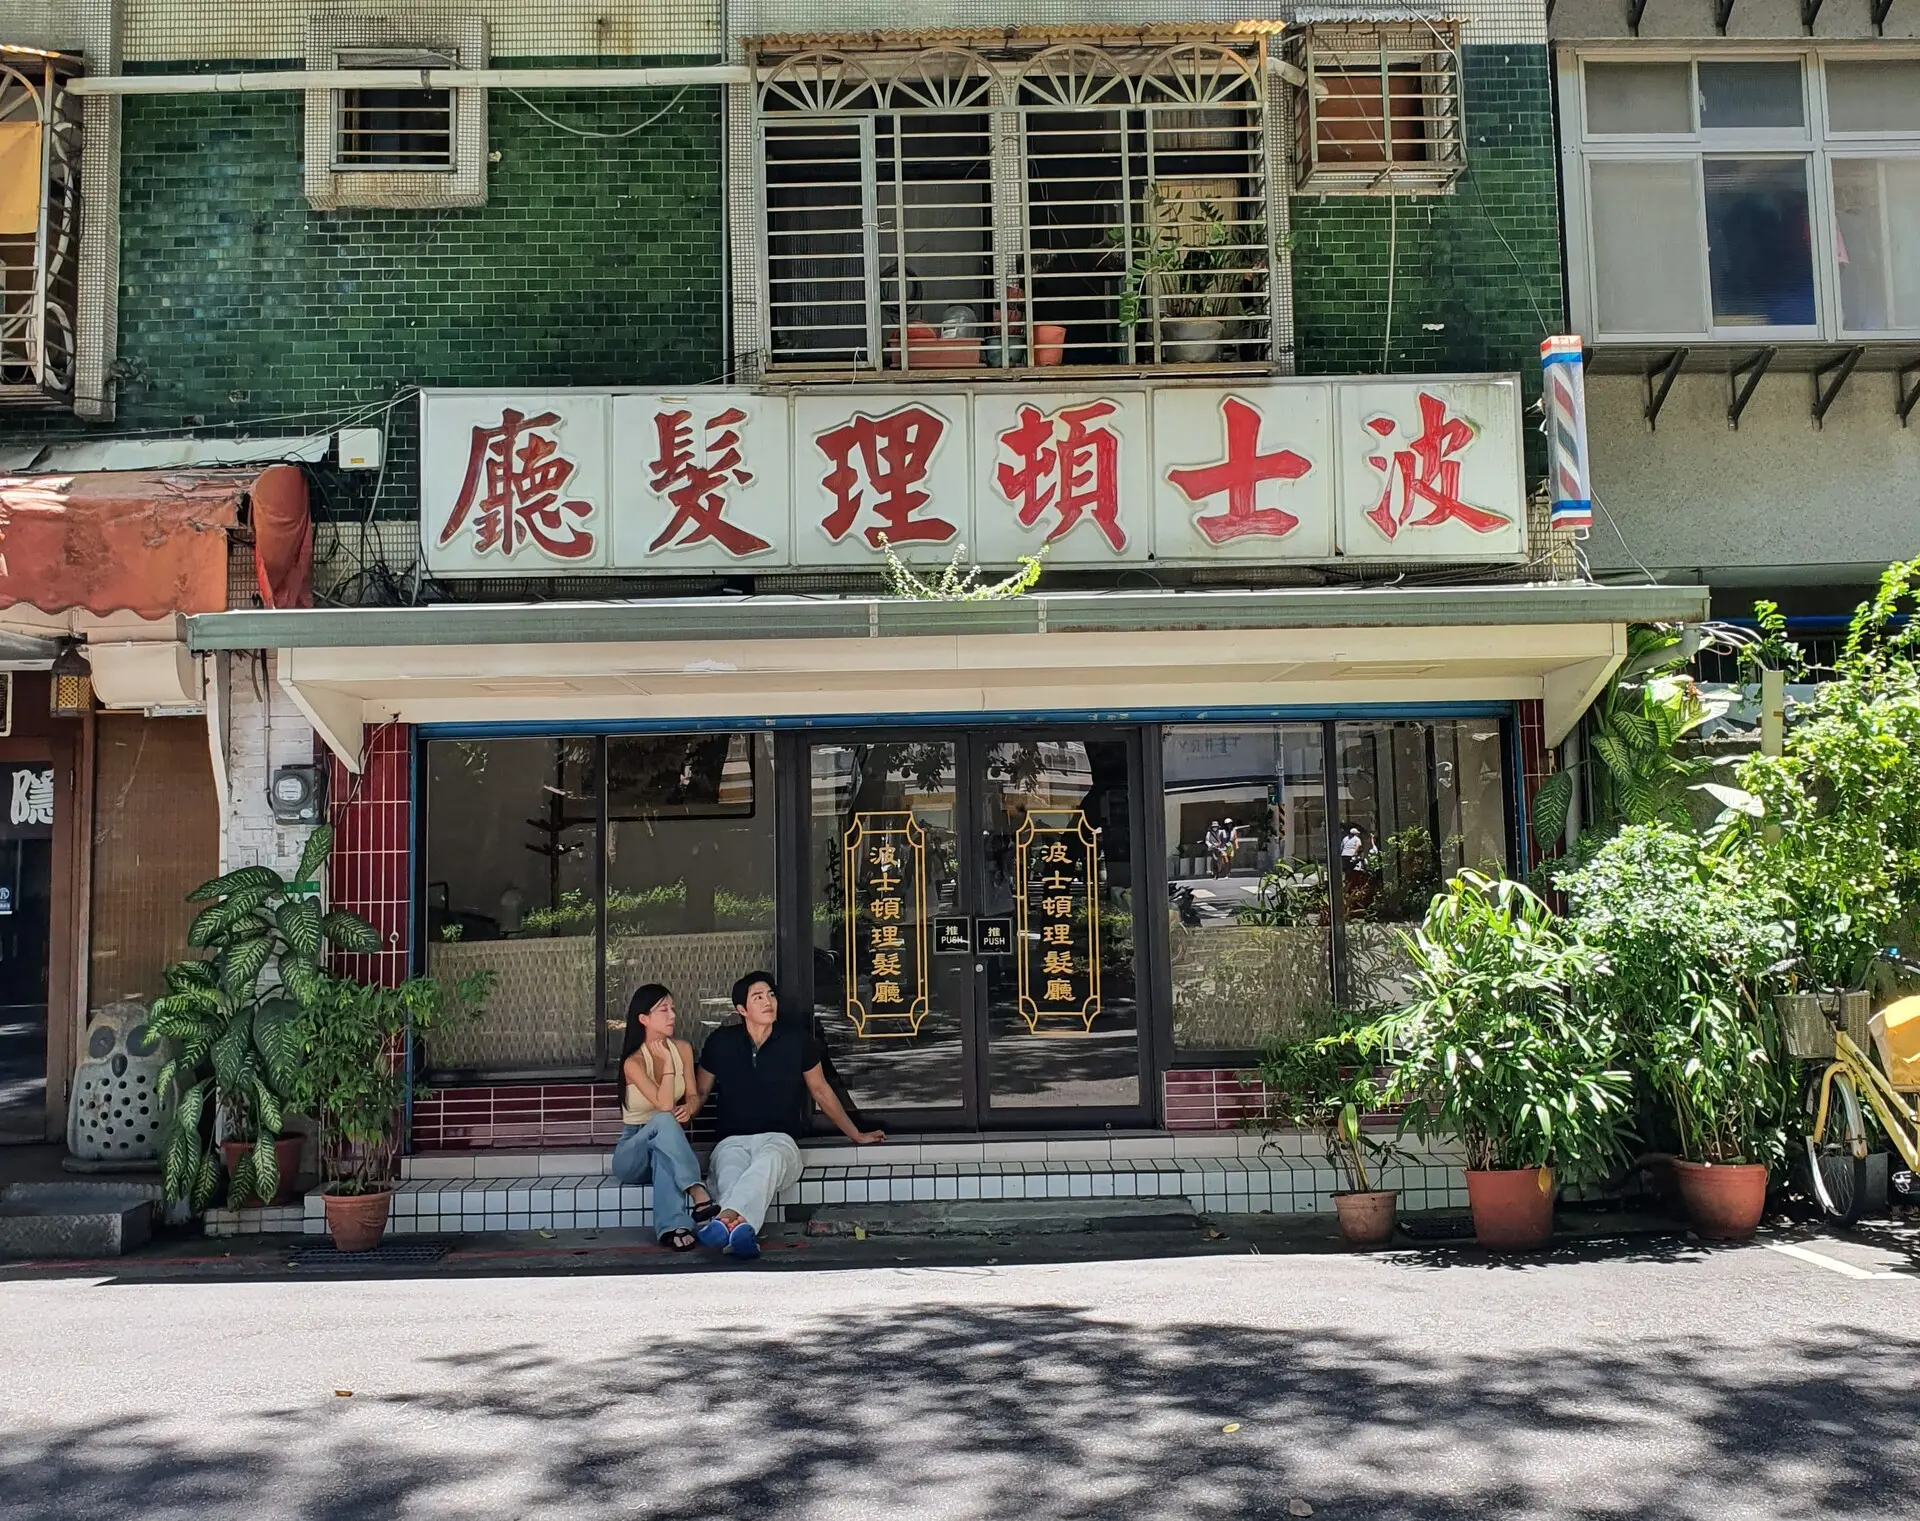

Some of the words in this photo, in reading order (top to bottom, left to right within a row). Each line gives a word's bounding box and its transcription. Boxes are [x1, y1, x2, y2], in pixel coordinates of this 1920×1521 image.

[440, 392, 1512, 557] 波士頓理髮廳
[869, 845, 904, 1004] 波士頓理髮廳
[1041, 844, 1076, 1001] 波士頓理髮廳
[945, 925, 959, 936] 推
[987, 927, 1001, 937] 推
[941, 936, 963, 944] PUSH
[983, 937, 1006, 945] PUSH
